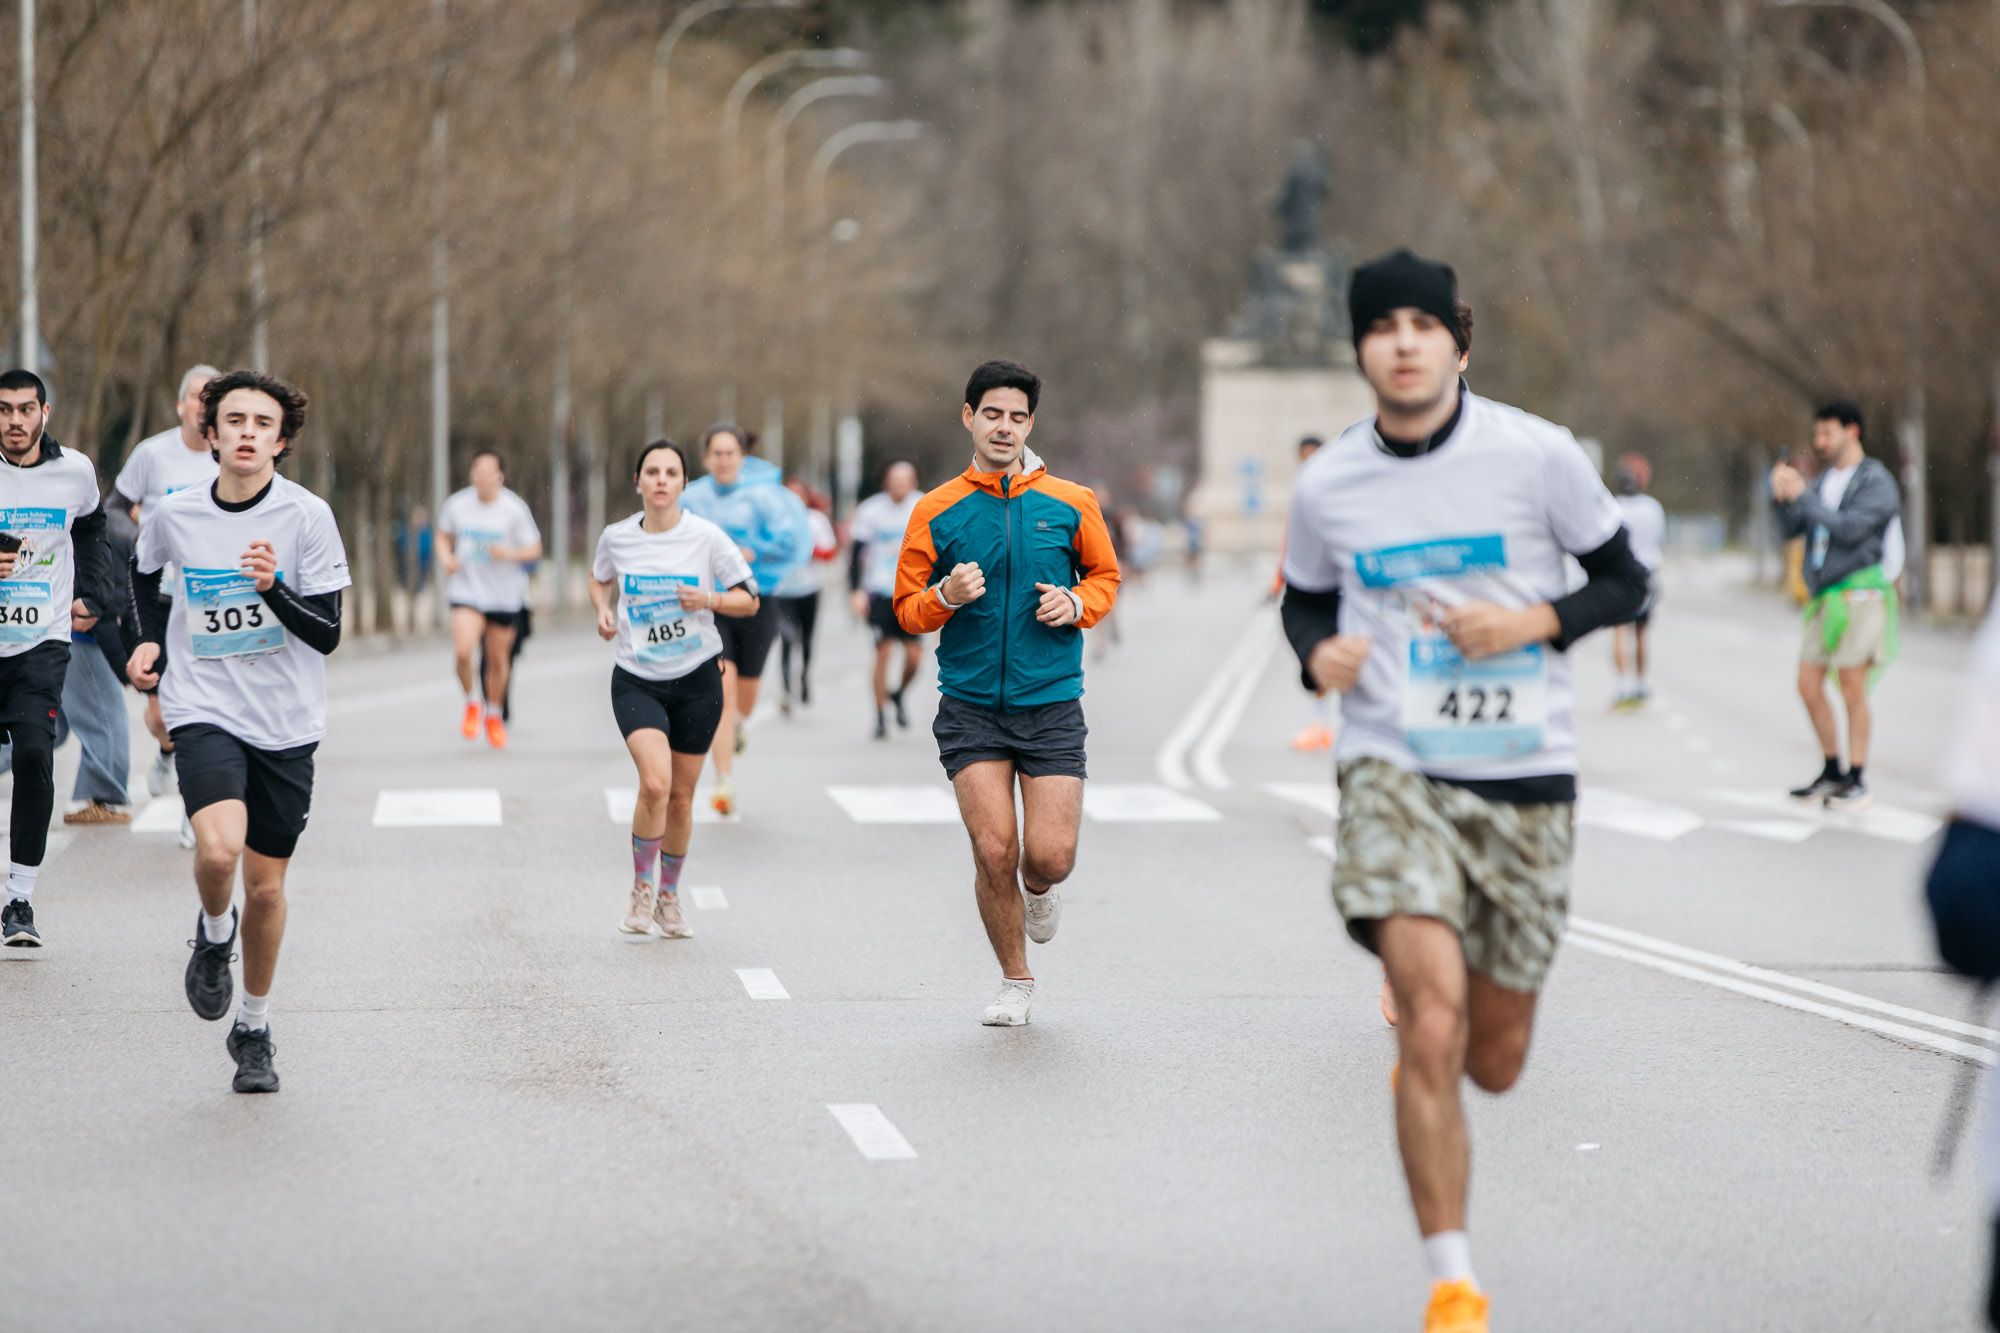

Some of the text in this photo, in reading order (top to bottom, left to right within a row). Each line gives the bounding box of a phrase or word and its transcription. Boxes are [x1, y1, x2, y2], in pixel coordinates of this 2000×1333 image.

[204, 604, 263, 633] 303
[647, 619, 686, 644] 485
[1439, 688, 1513, 721] 422
